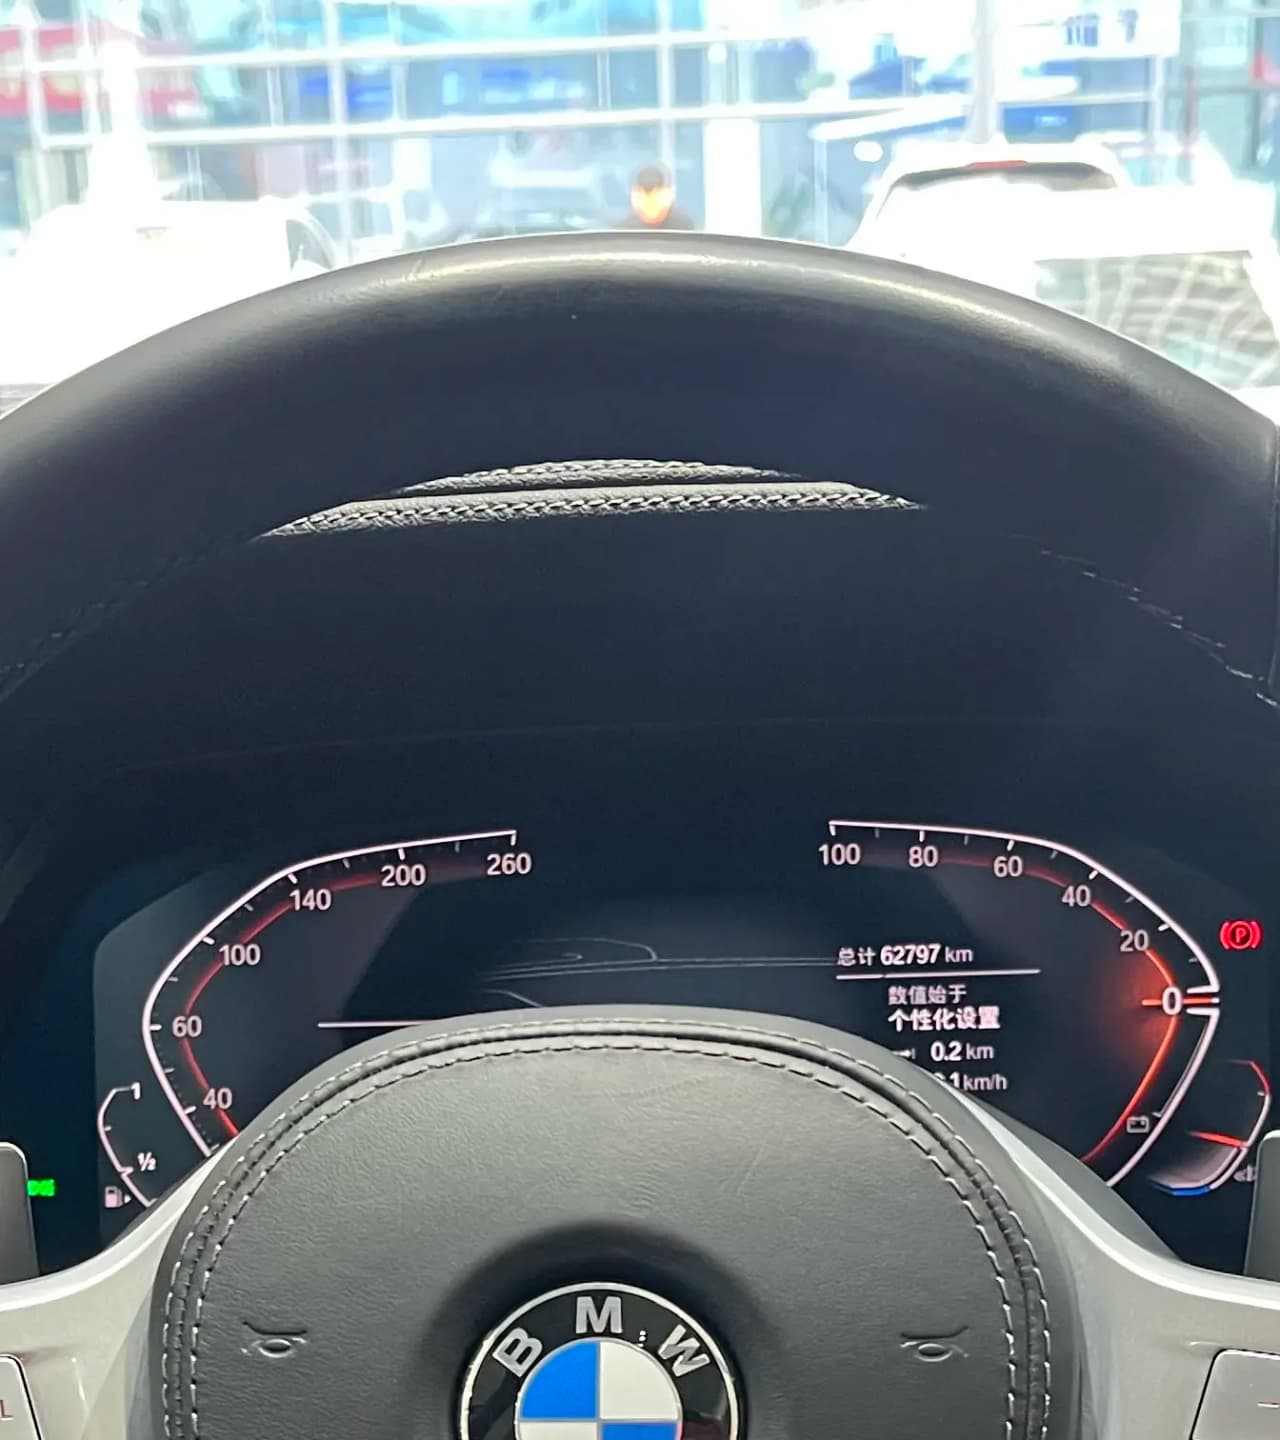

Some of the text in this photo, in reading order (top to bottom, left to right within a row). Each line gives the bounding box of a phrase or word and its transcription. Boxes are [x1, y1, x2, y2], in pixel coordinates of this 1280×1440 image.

[486, 853, 531, 876] 260
[820, 843, 860, 865] 100
[909, 846, 938, 867] 80
[381, 865, 426, 887] 200
[994, 856, 1023, 878] 60
[290, 888, 331, 910] 140
[1062, 885, 1091, 908] 40
[1120, 930, 1149, 952] 20
[220, 944, 261, 966] 100
[837, 944, 974, 966] 总计 62797 km
[888, 984, 967, 1005] 数值始于
[1162, 988, 1182, 1013] 0
[172, 1016, 202, 1037] 60
[888, 1006, 1001, 1032] 个性化设置
[930, 1041, 995, 1062] 0.2 km
[131, 1082, 141, 1100] 1
[963, 1073, 1008, 1091] km/h
[203, 1088, 233, 1109] 40
[493, 1295, 709, 1377] BMW
